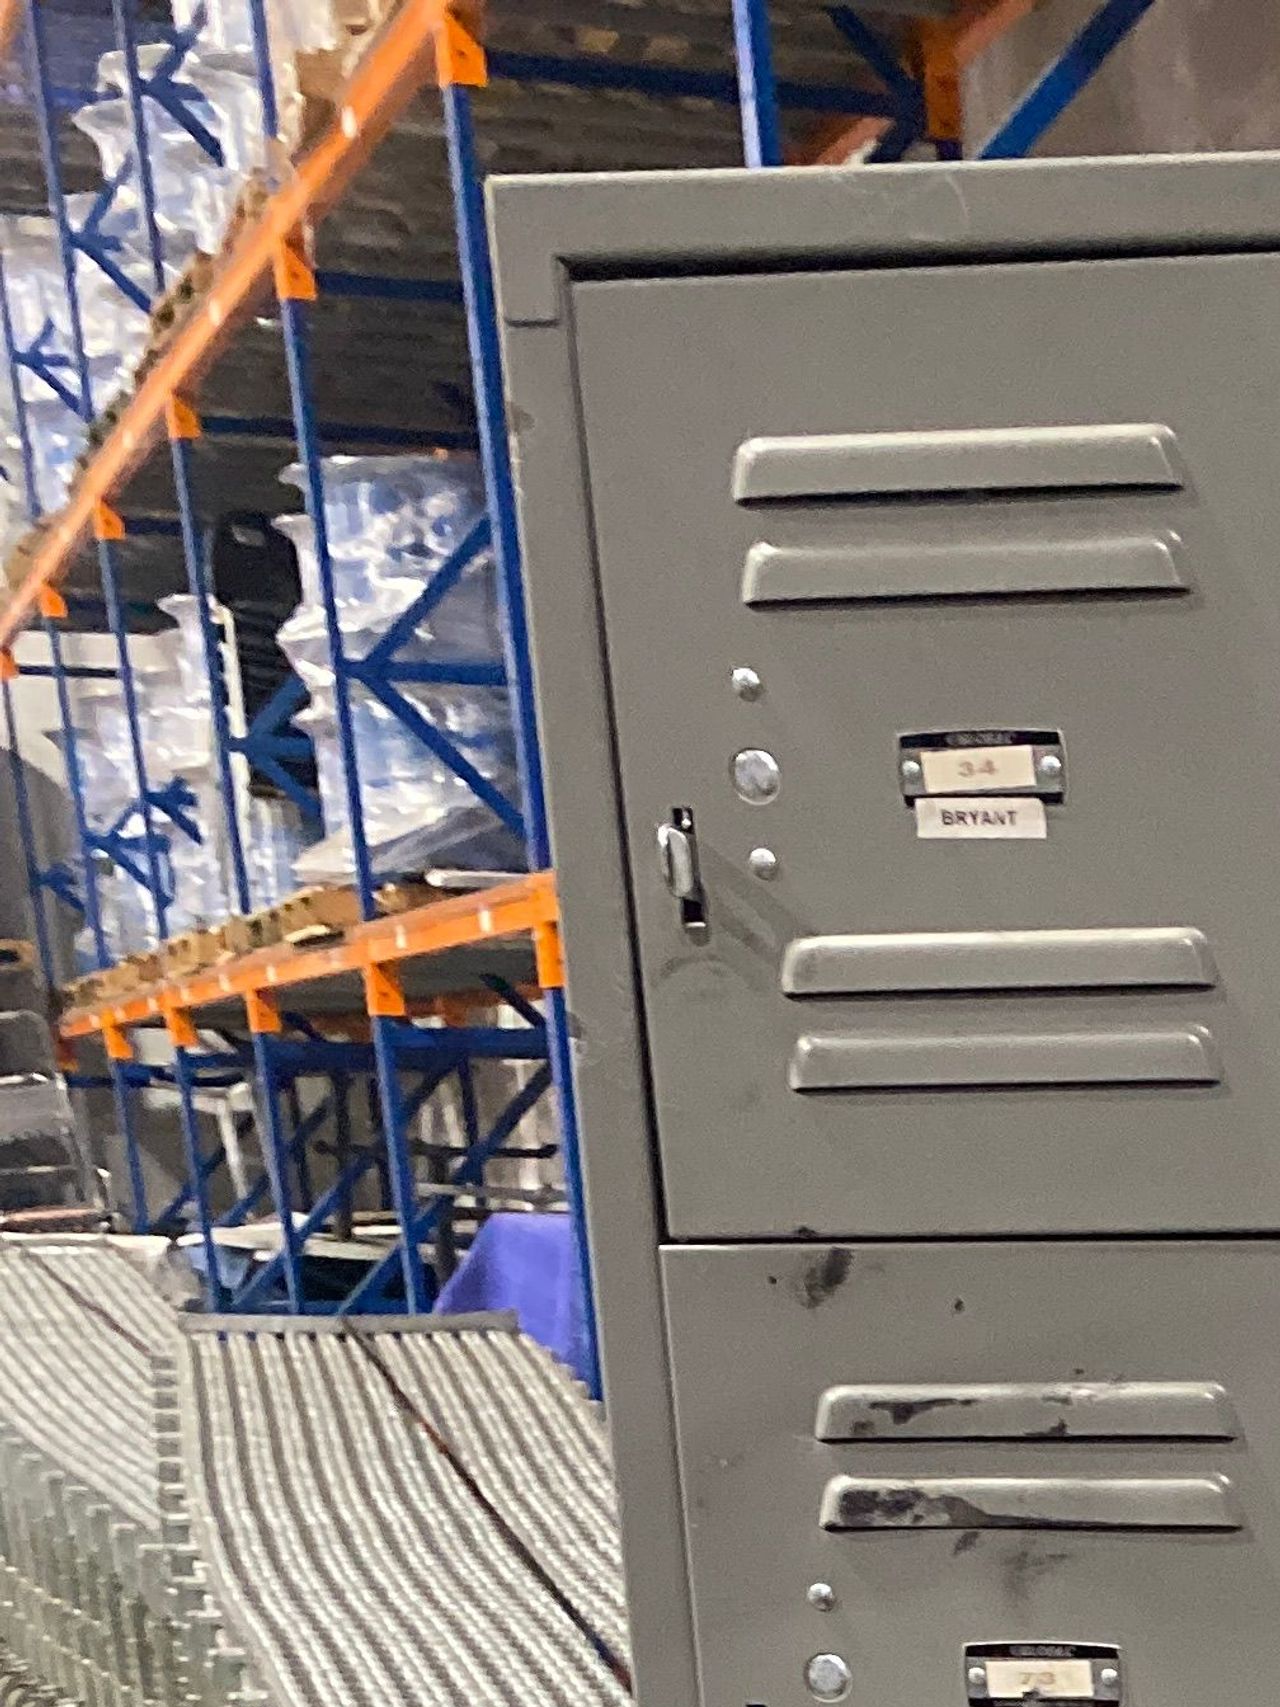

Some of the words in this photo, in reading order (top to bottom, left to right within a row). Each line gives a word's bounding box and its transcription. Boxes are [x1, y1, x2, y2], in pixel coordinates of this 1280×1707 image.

[958, 759, 996, 777] 34
[940, 809, 1018, 826] BRYANT
[1019, 1671, 1056, 1686] 73
